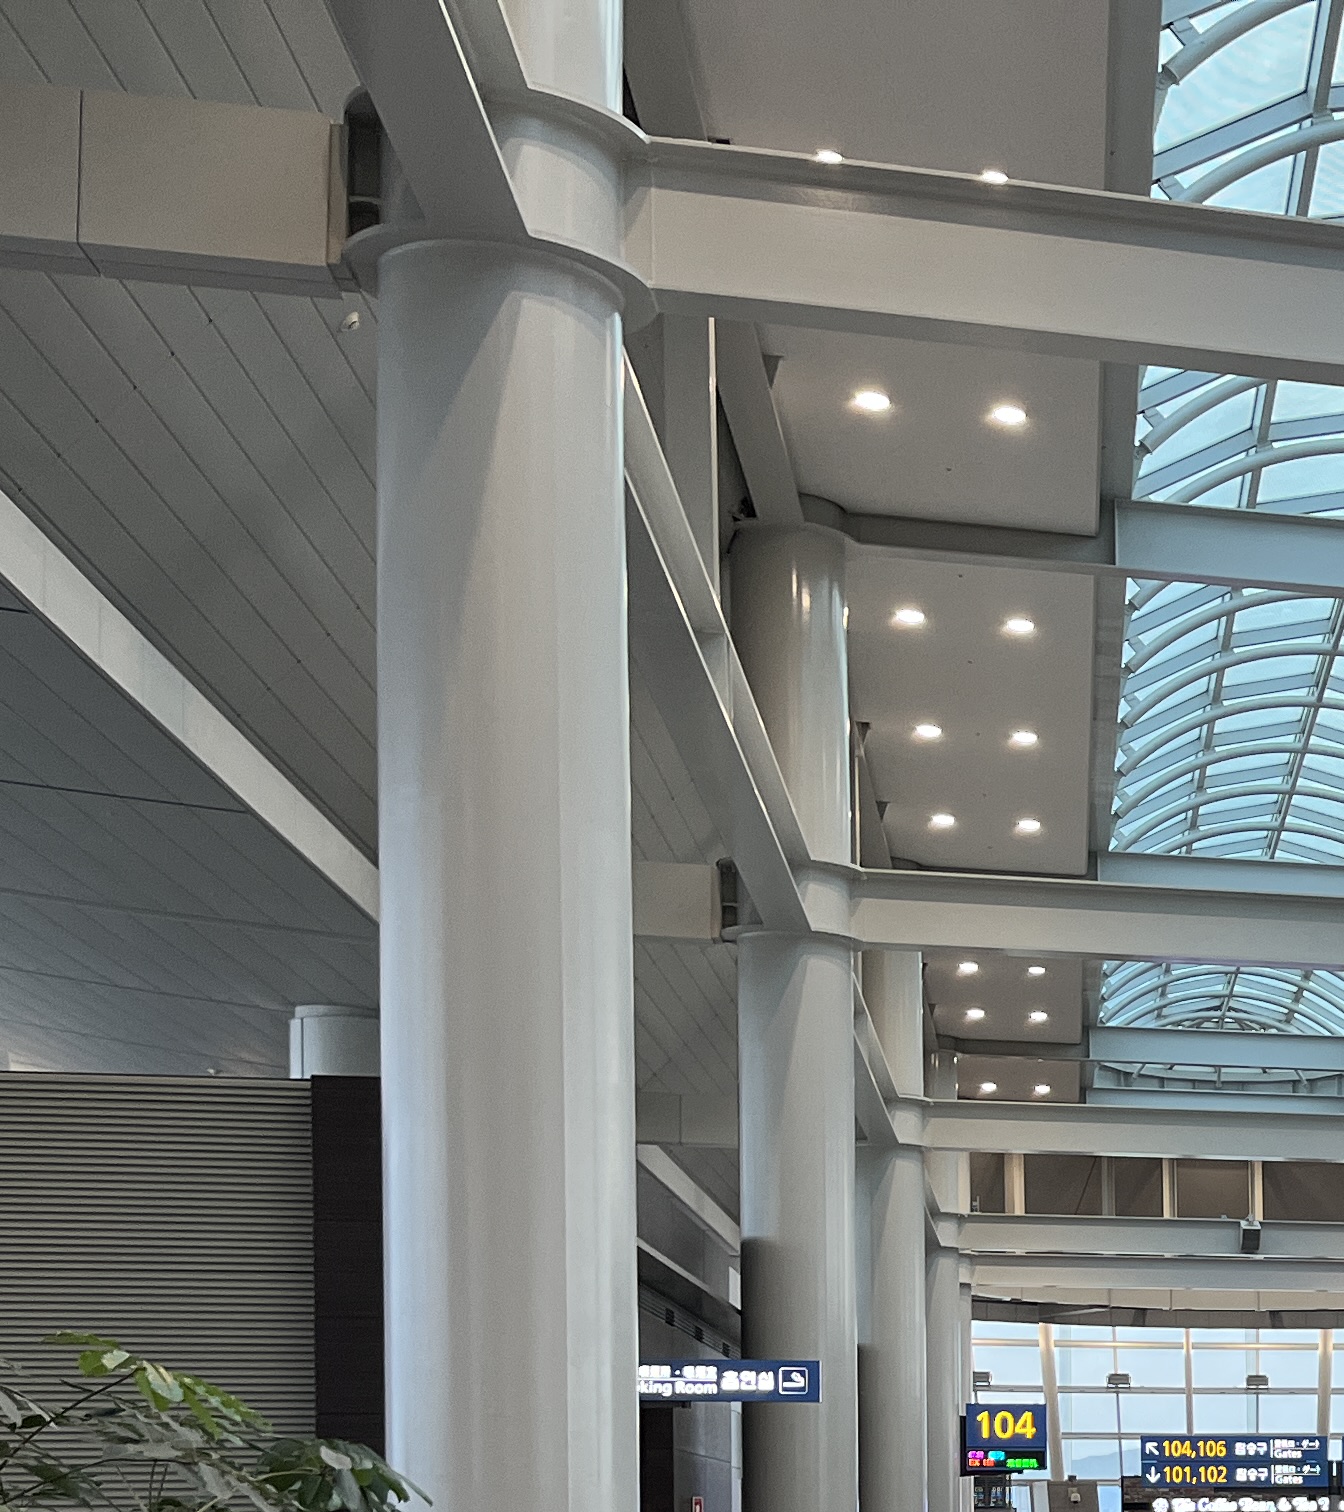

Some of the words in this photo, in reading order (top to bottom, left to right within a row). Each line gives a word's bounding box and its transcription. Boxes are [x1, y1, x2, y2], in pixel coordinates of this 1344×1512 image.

[674, 1380, 718, 1395] Room
[976, 1410, 1037, 1439] 104
[1162, 1439, 1227, 1459] 104,106
[1273, 1449, 1303, 1459] Gates
[1163, 1465, 1228, 1485] 101,102
[1274, 1474, 1304, 1485] Gates
